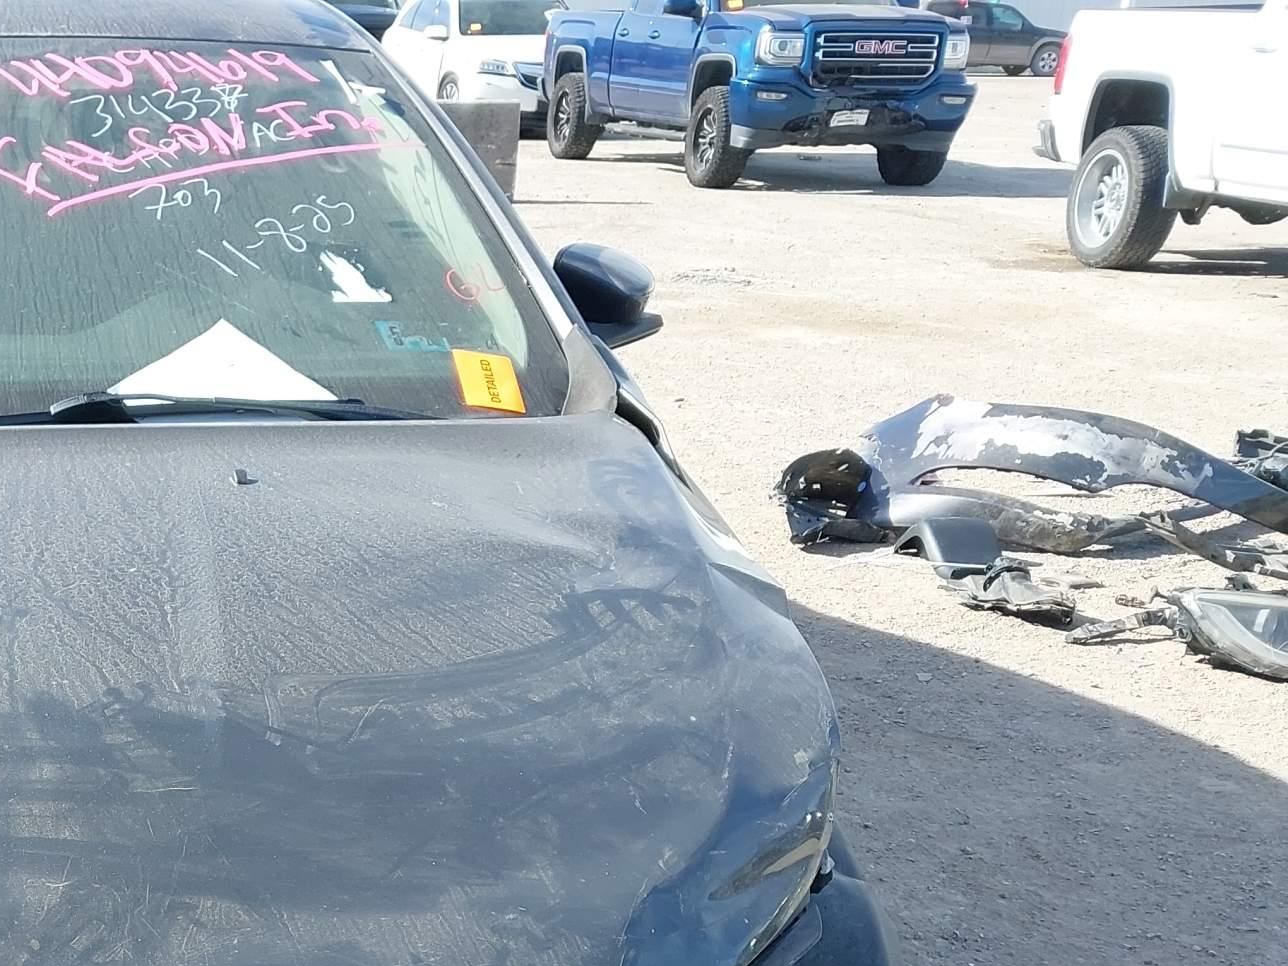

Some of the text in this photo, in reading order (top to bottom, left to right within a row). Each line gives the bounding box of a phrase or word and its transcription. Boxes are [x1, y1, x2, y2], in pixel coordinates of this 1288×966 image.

[855, 40, 908, 54] GMC
[127, 178, 221, 220] 703
[196, 195, 356, 277] 11-8-25
[479, 359, 502, 404] DETAILED
